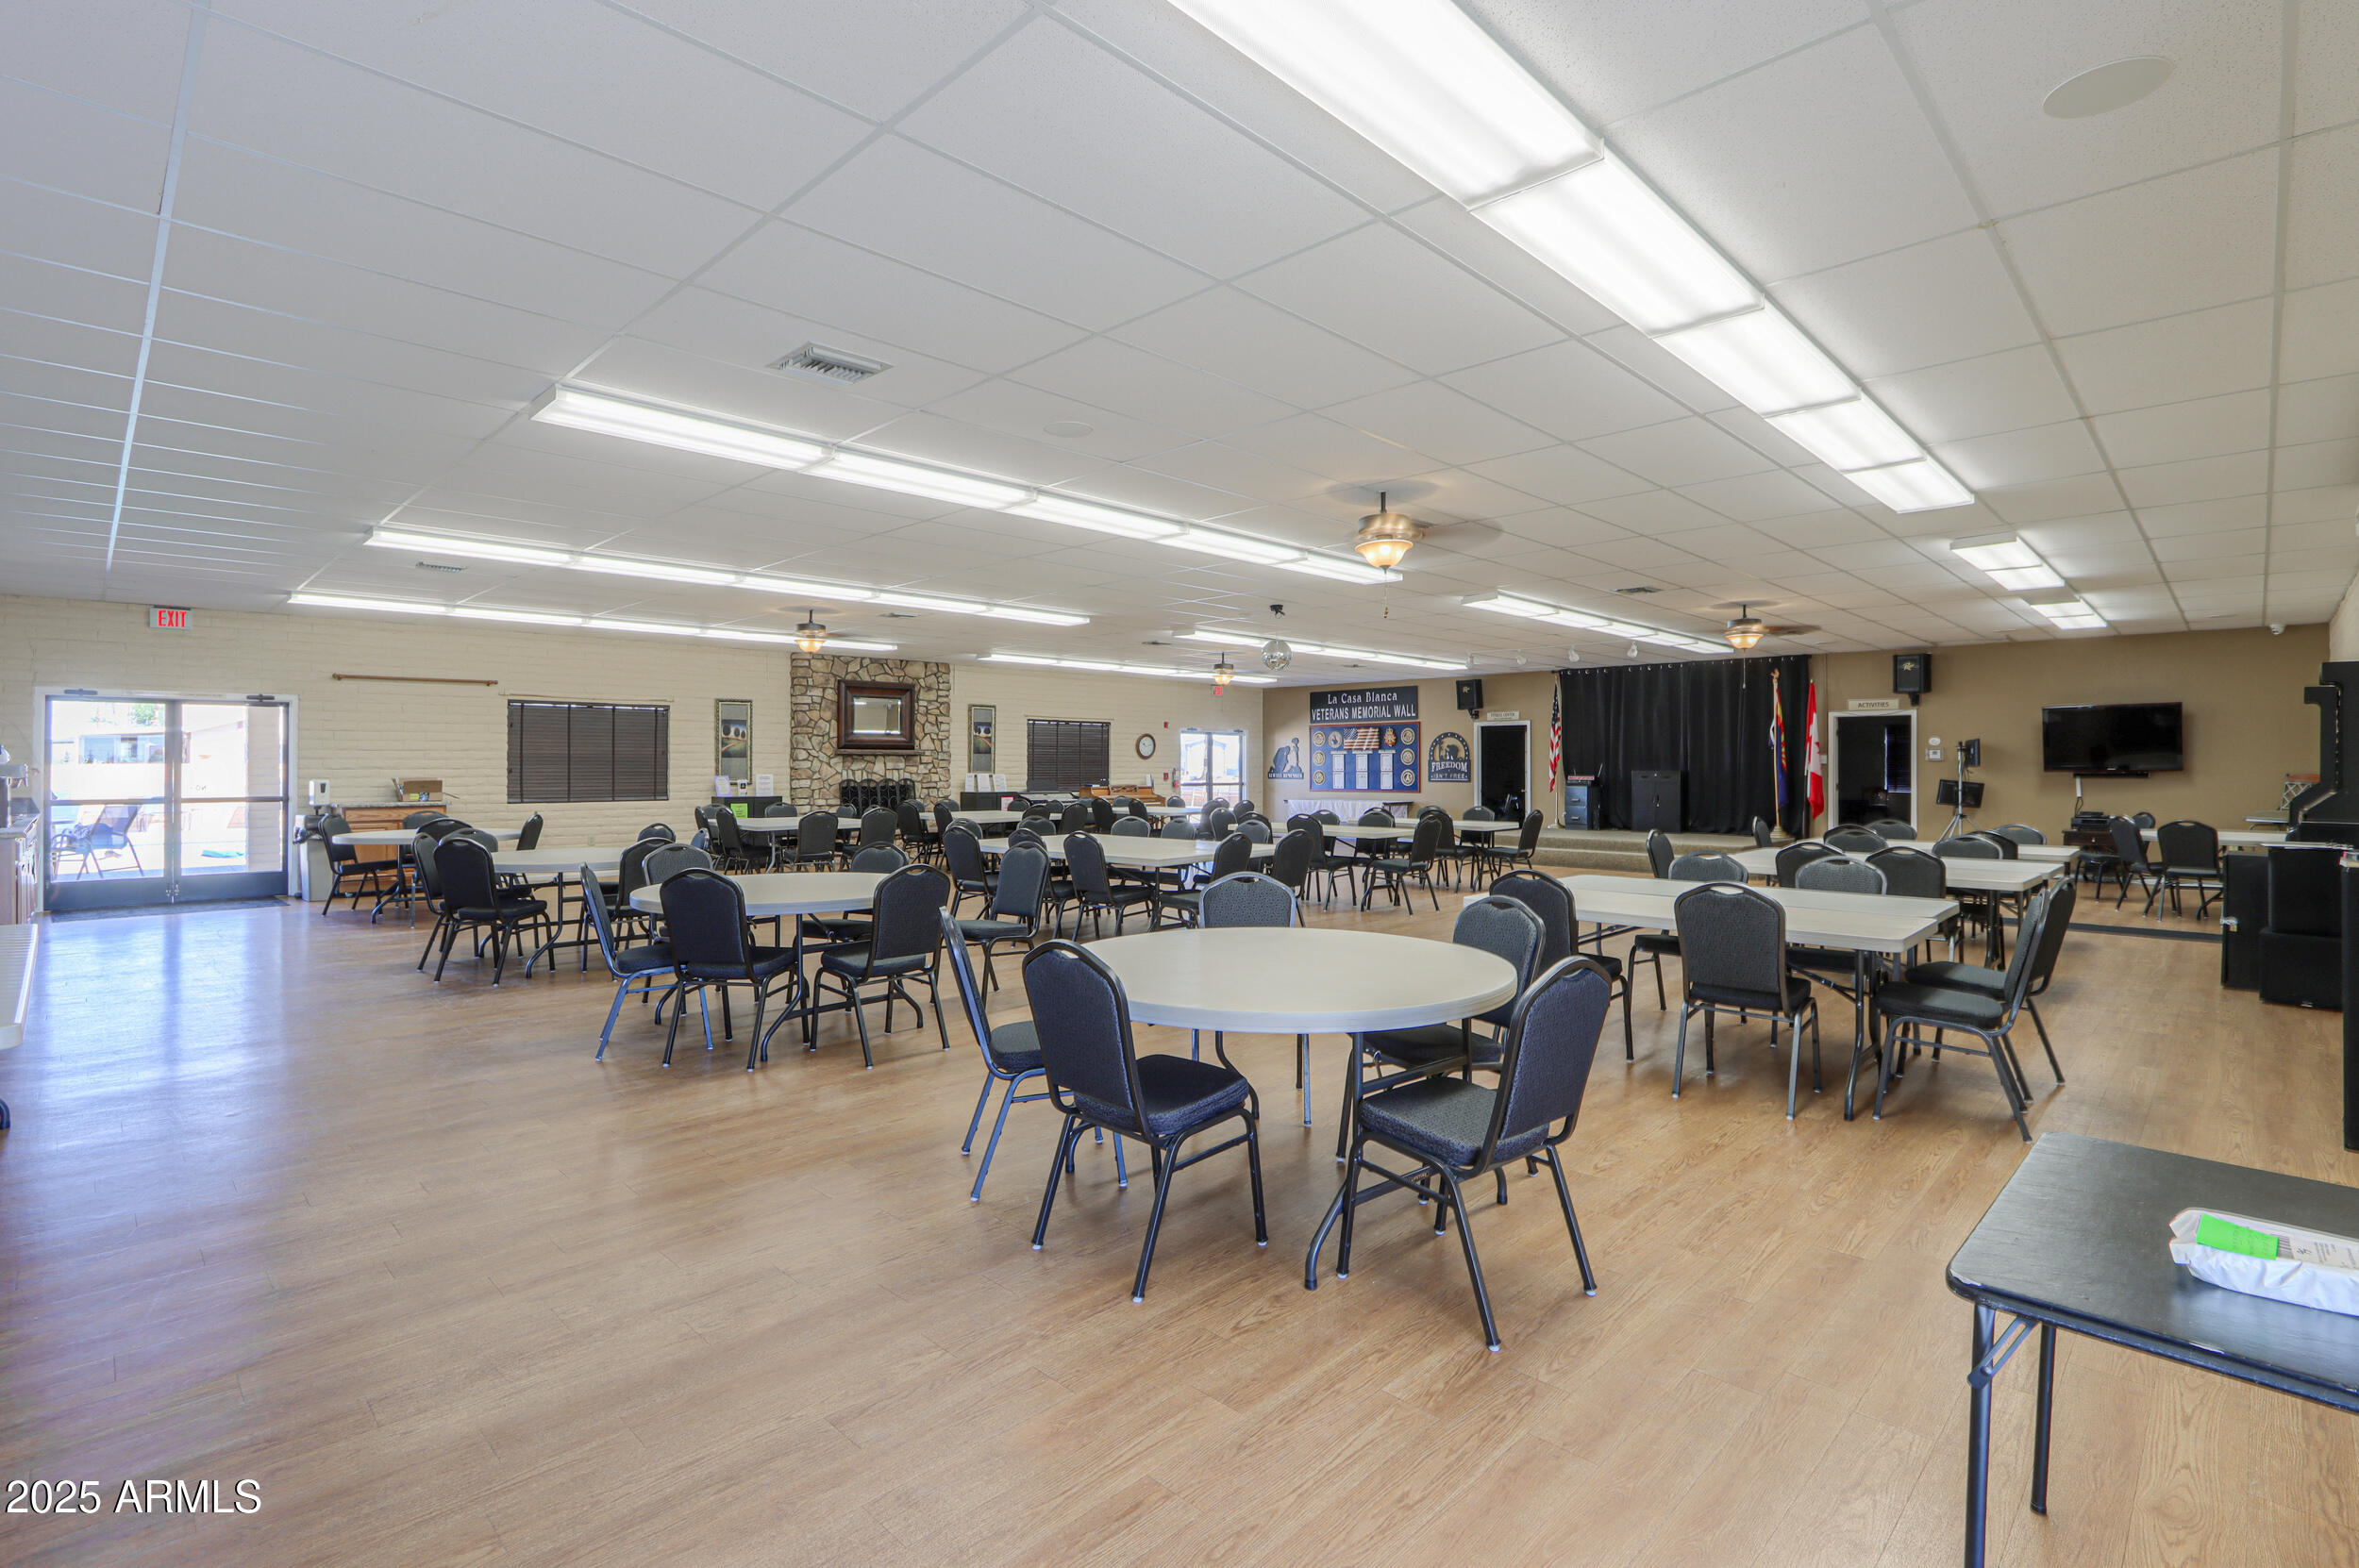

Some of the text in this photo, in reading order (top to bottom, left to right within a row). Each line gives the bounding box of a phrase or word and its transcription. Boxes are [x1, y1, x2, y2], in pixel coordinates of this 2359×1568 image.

[158, 609, 187, 627] EXIT
[1328, 692, 1397, 704] La Casa Blanca
[1312, 704, 1416, 721] VETERANS MEMORIAL WALL
[1431, 761, 1468, 773] FREEDOM
